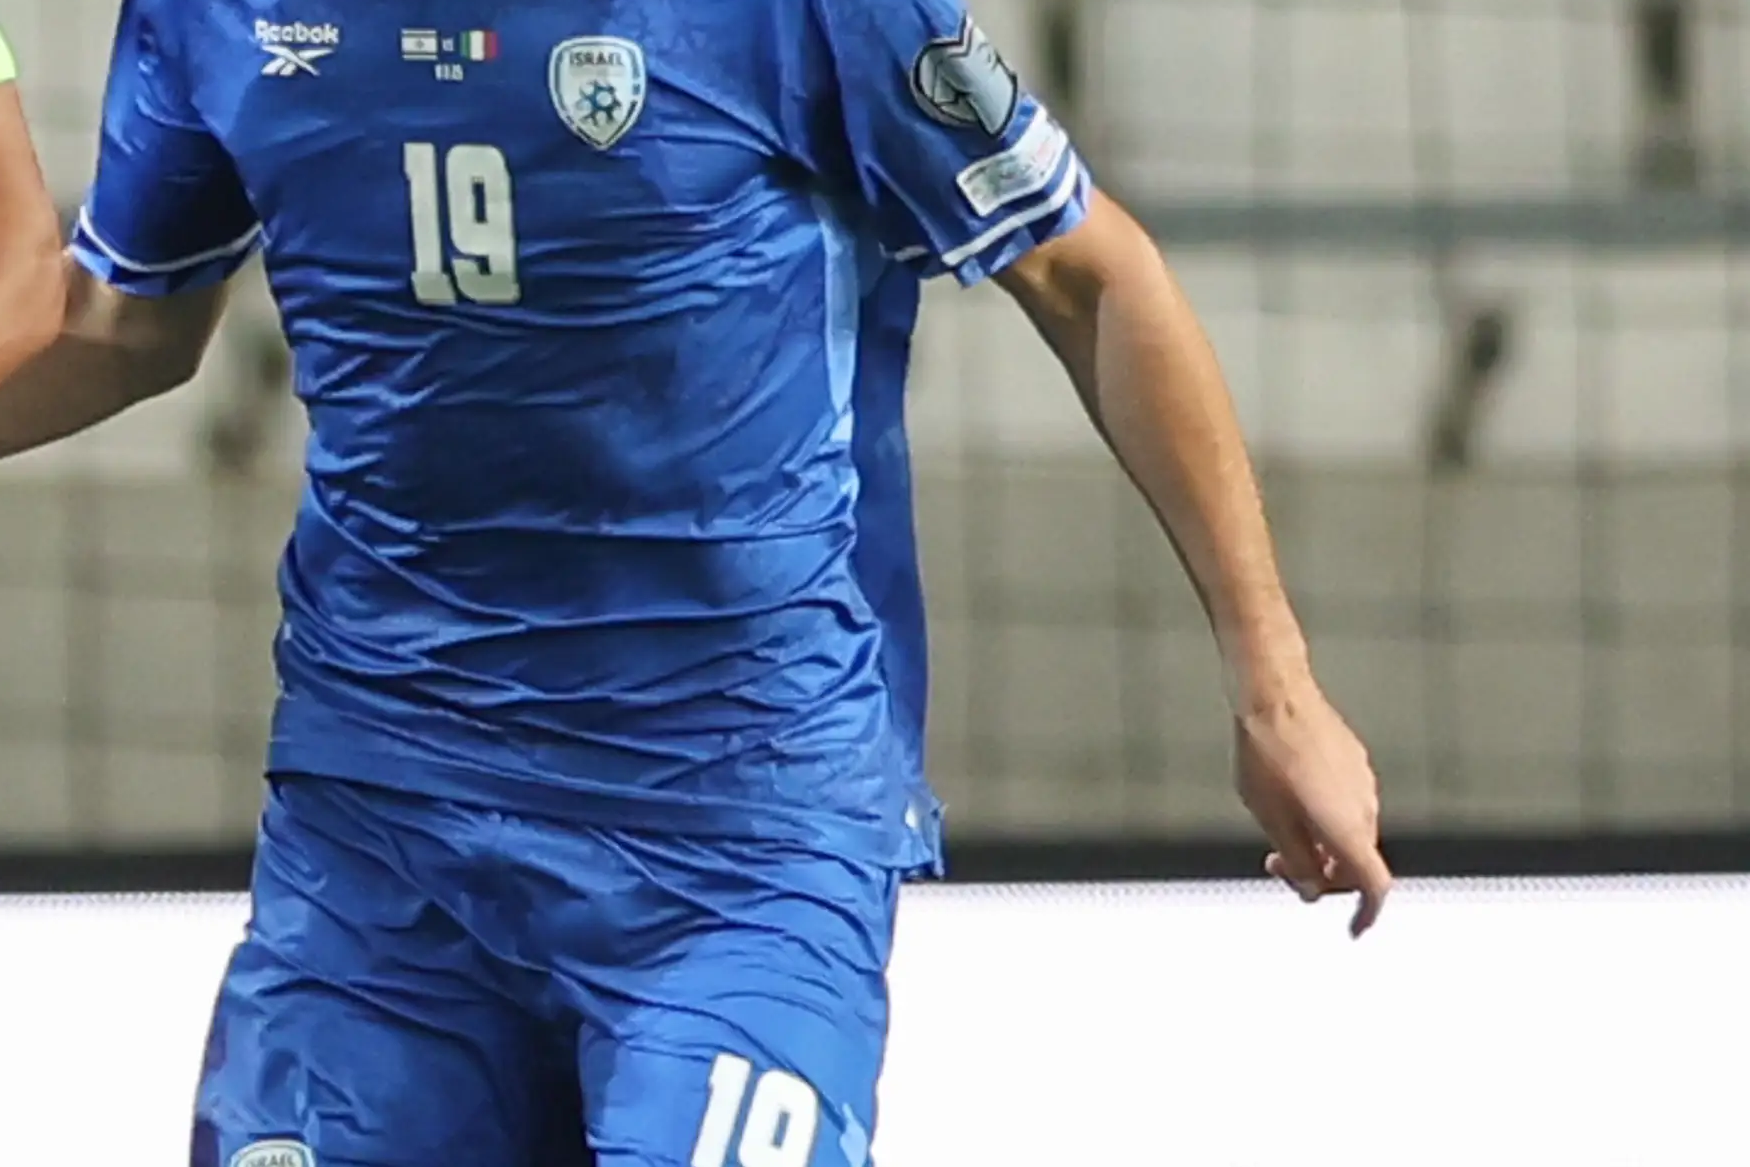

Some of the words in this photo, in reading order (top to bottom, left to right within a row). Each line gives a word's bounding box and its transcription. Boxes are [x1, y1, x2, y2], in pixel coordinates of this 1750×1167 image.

[255, 20, 339, 44] Reebok
[570, 52, 624, 66] ISRAEL
[404, 142, 521, 305] 19
